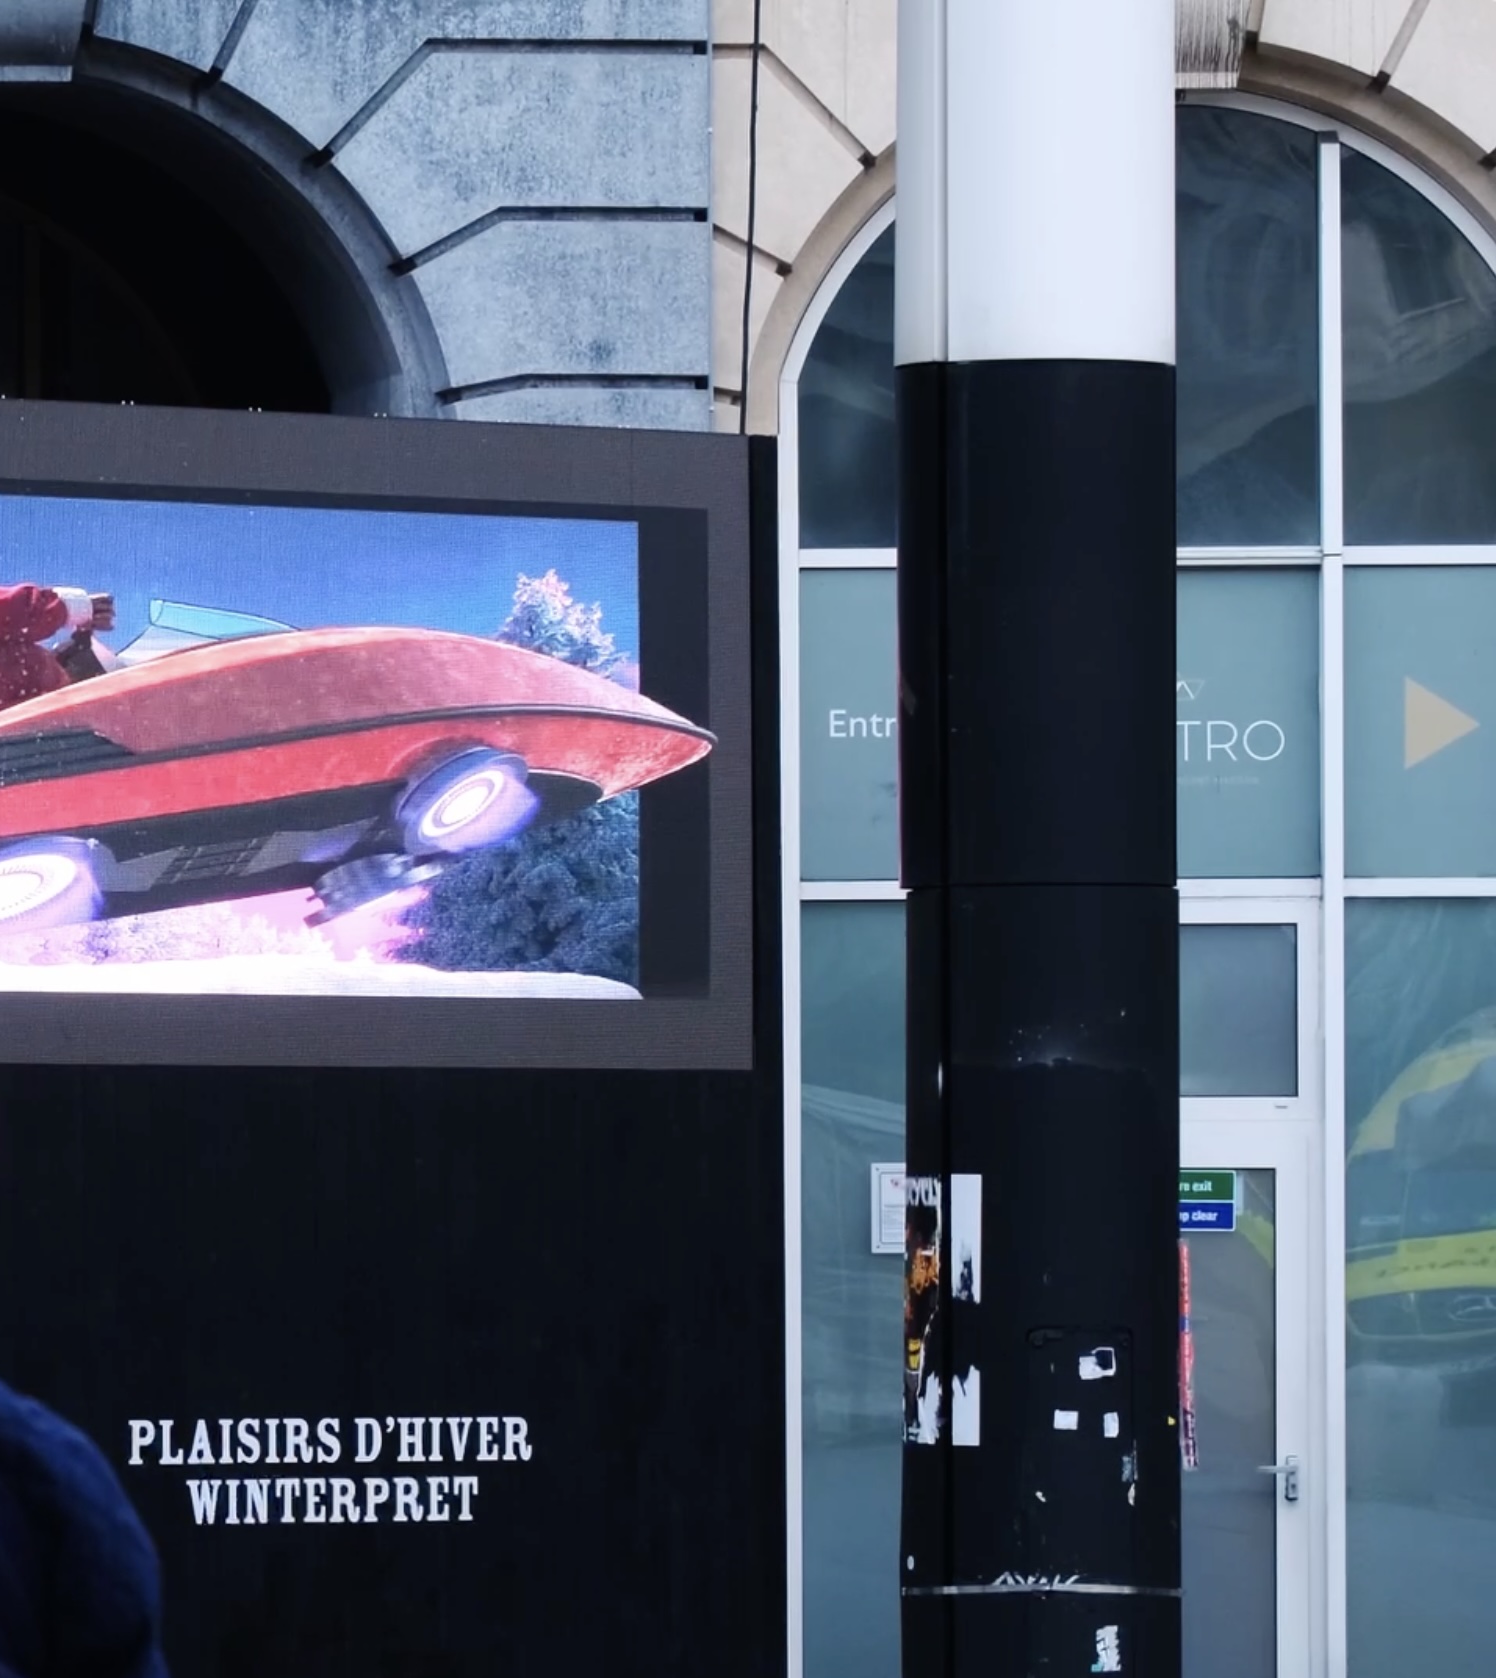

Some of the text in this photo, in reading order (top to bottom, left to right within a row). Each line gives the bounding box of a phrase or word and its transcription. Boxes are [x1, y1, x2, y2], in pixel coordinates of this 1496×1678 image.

[829, 708, 898, 738] Entr
[1176, 719, 1286, 762] TRO
[1191, 1209, 1218, 1222] clear
[127, 1415, 534, 1466] PLAISIRS D'HIVER
[184, 1475, 480, 1526] WINTERPRET
